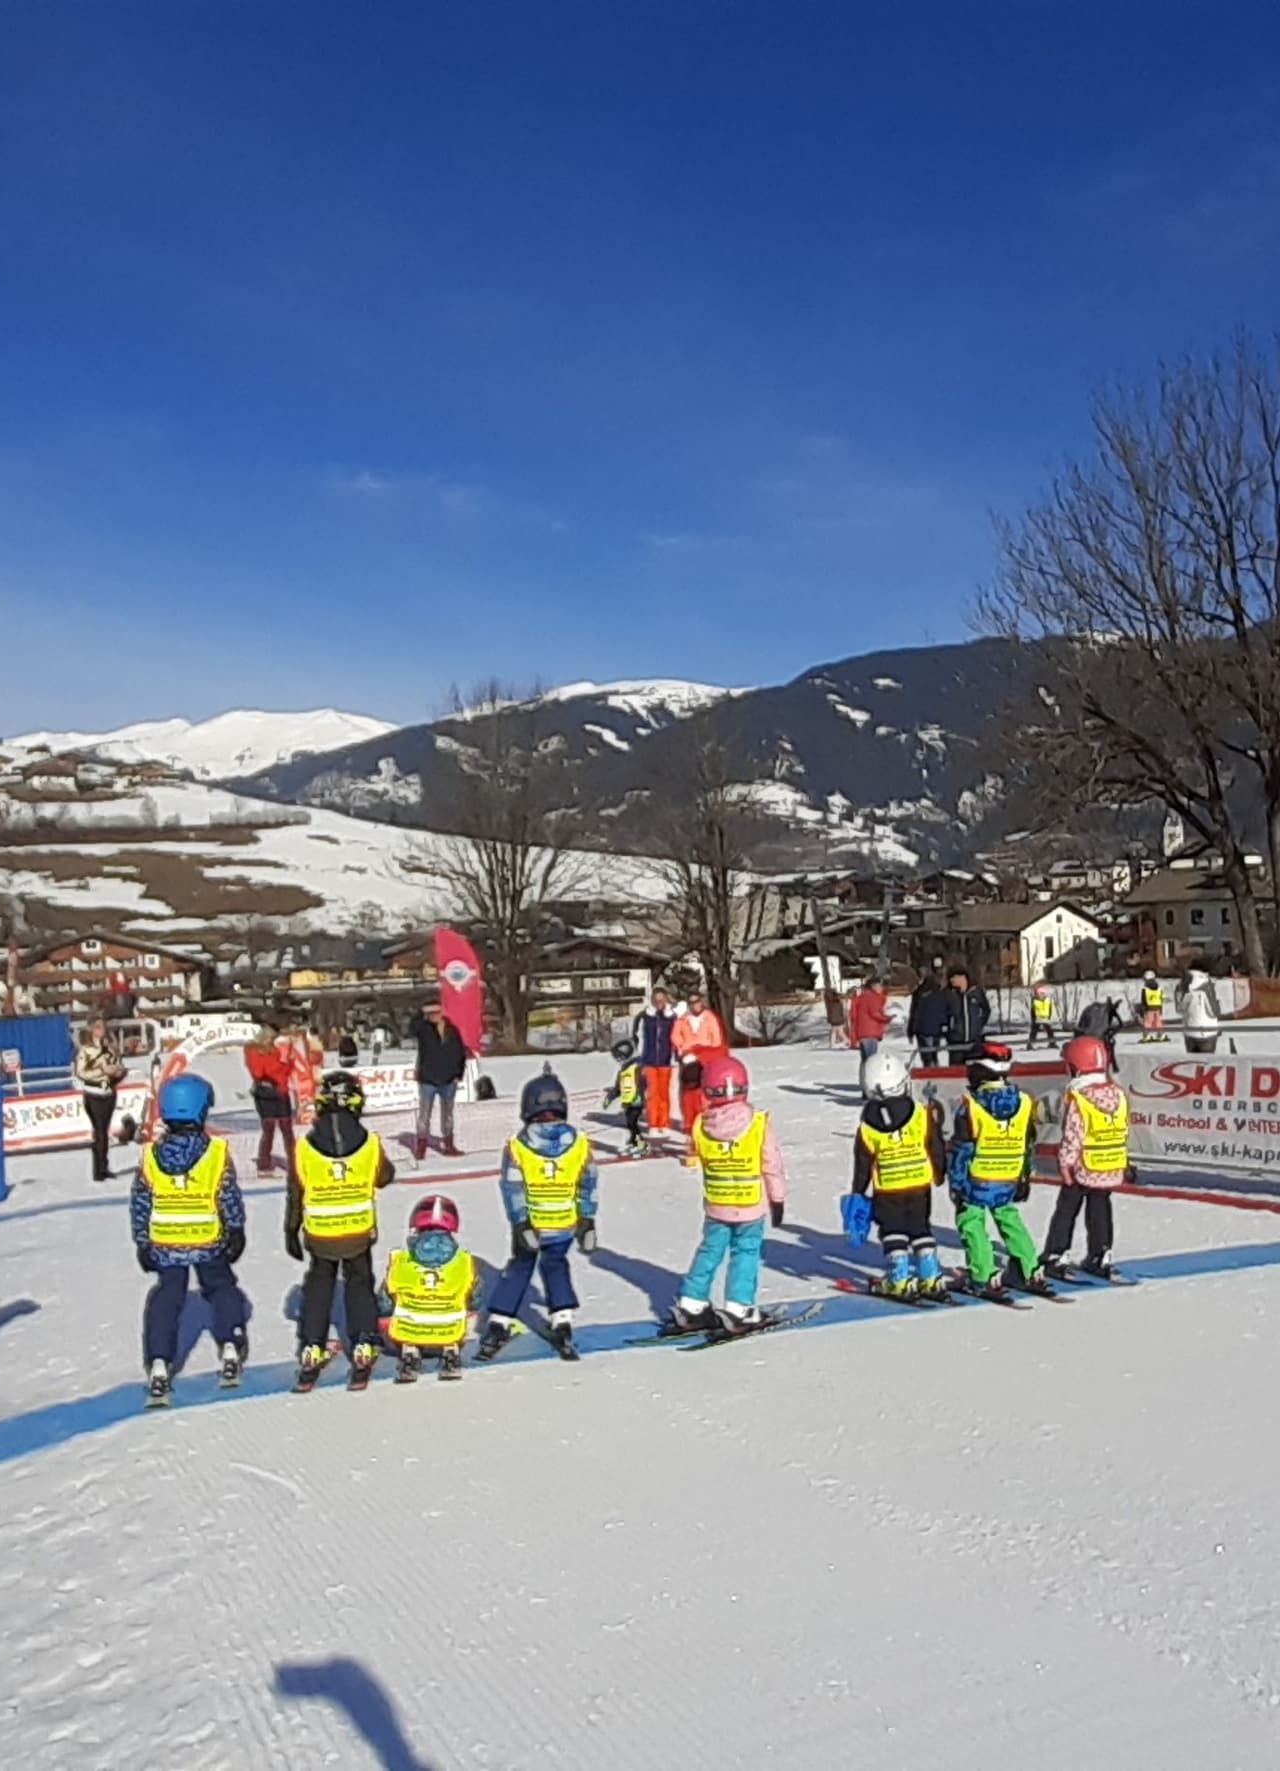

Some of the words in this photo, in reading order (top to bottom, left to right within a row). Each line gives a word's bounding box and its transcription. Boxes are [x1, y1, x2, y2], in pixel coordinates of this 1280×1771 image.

[1129, 1061, 1236, 1099] SKI
[1129, 1112, 1152, 1126] Ski
[1157, 1114, 1211, 1131] School
[1216, 1118, 1228, 1131] &
